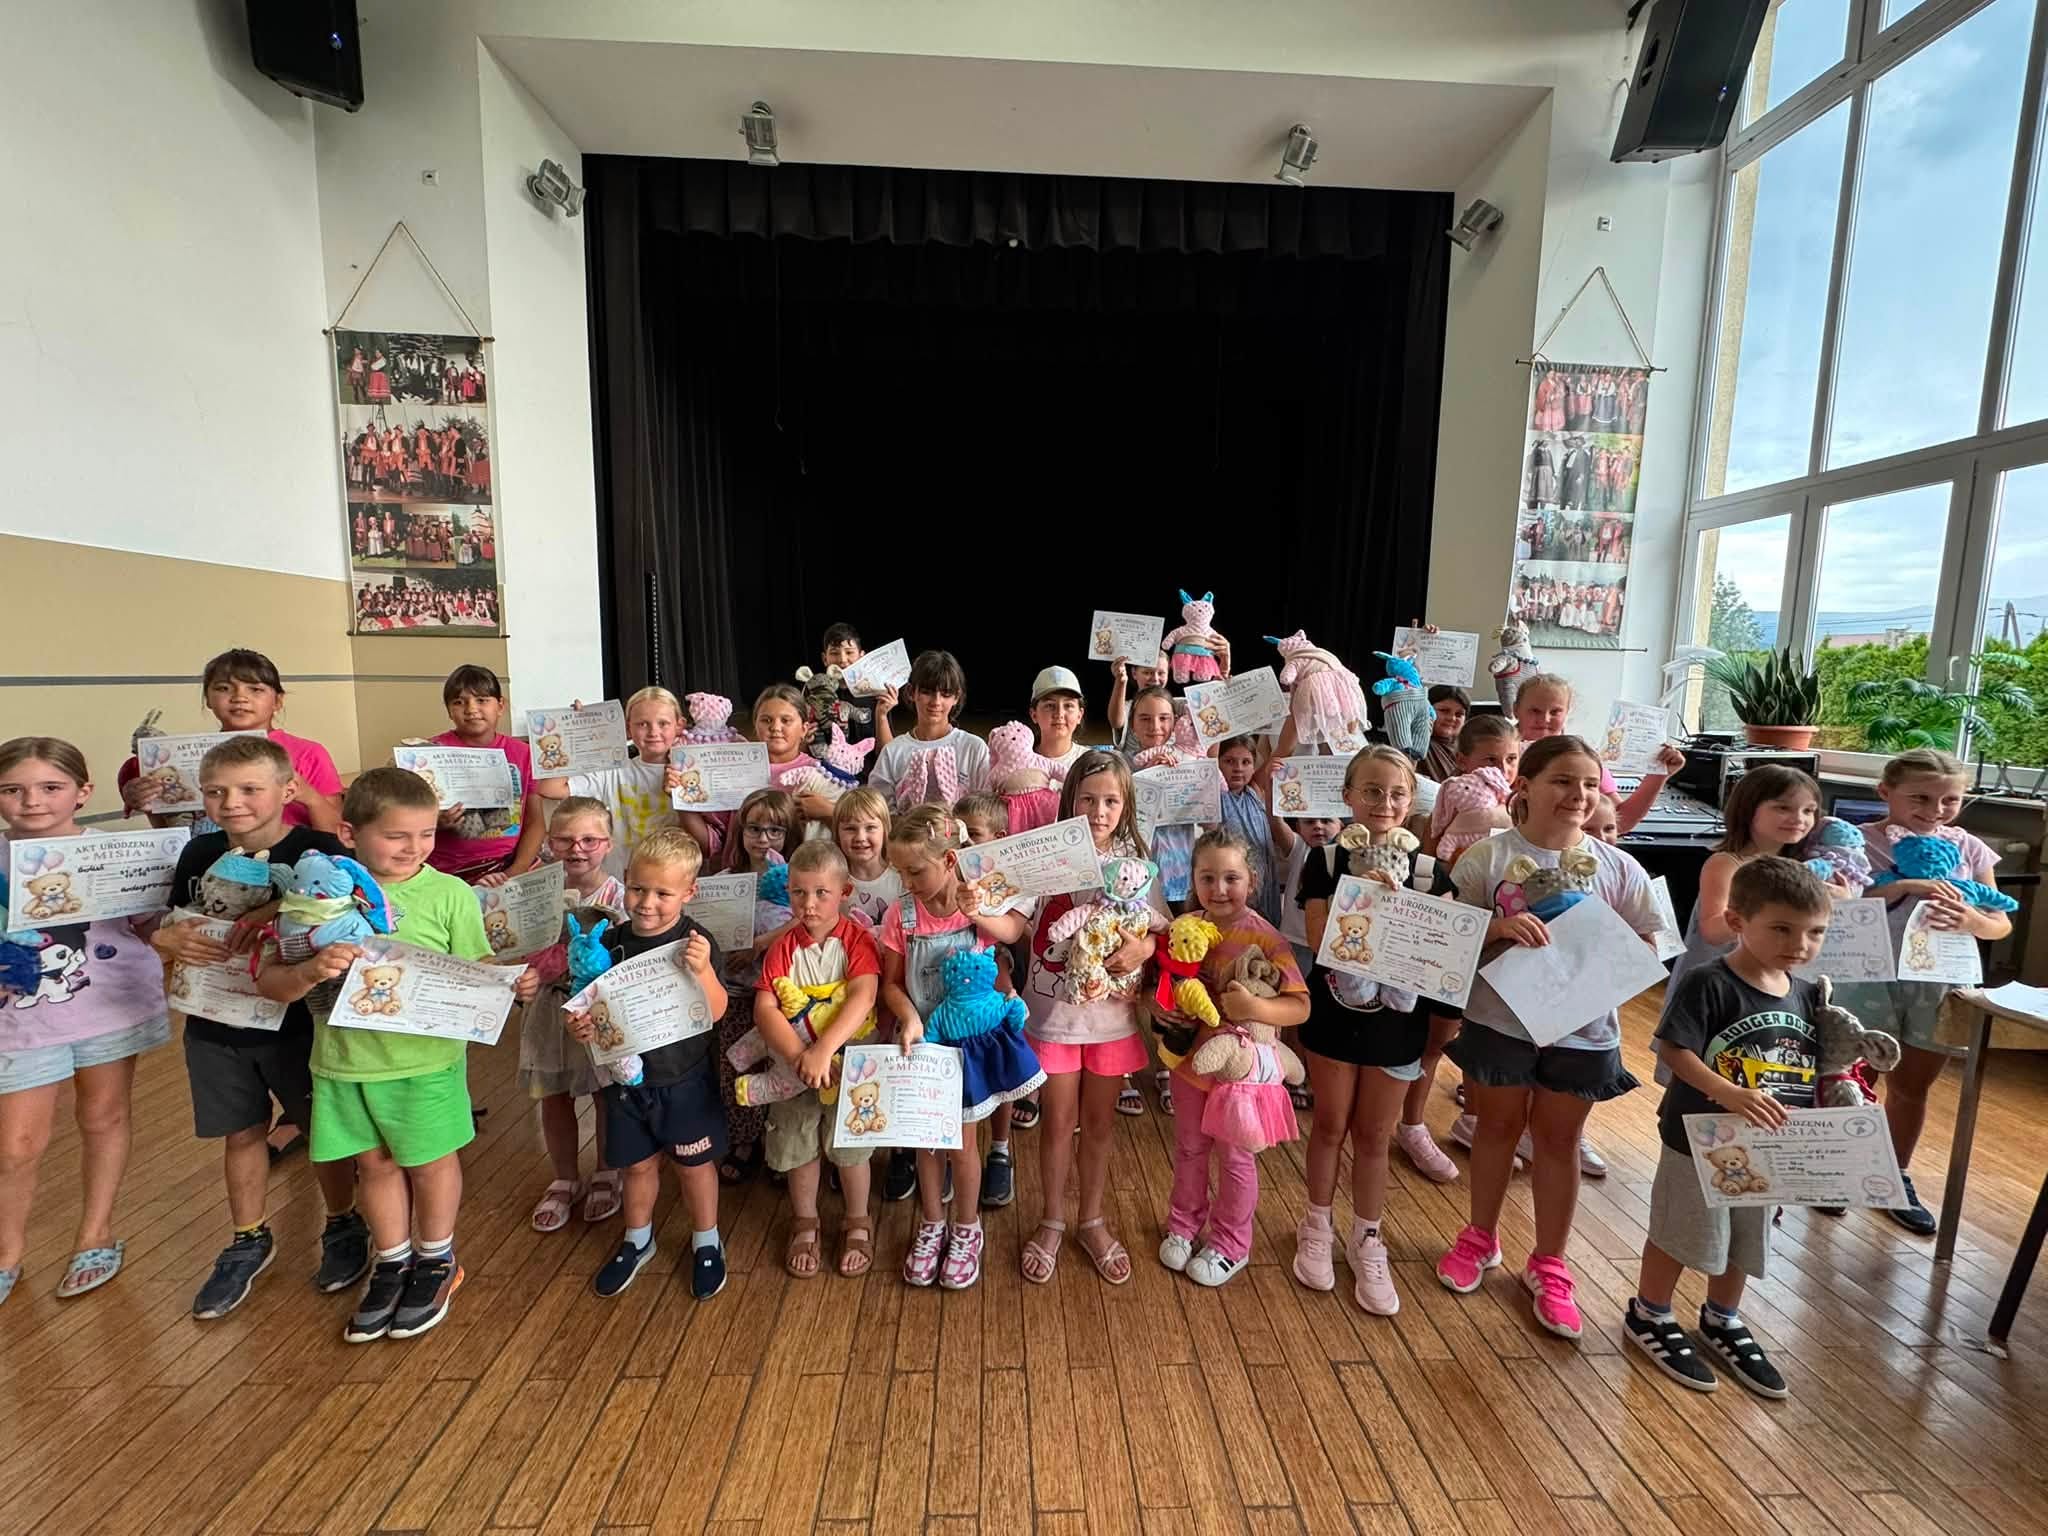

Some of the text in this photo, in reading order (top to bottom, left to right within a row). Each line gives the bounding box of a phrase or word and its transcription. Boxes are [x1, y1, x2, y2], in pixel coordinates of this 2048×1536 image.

[75, 840, 156, 855] AKT URODZENIA
[93, 849, 142, 862] MISIA
[999, 835, 1058, 857] AKT URODZENIA
[1013, 844, 1050, 862] MISIA
[1380, 895, 1449, 921] AKT URODZENIA
[1392, 906, 1433, 925] MISIA
[603, 956, 667, 981] AKT URODZENIA
[619, 966, 658, 985] MISIA
[1720, 1013, 1781, 1042] RODGER
[896, 1062, 931, 1073] MISIA
[675, 1135, 712, 1156] MARVEL
